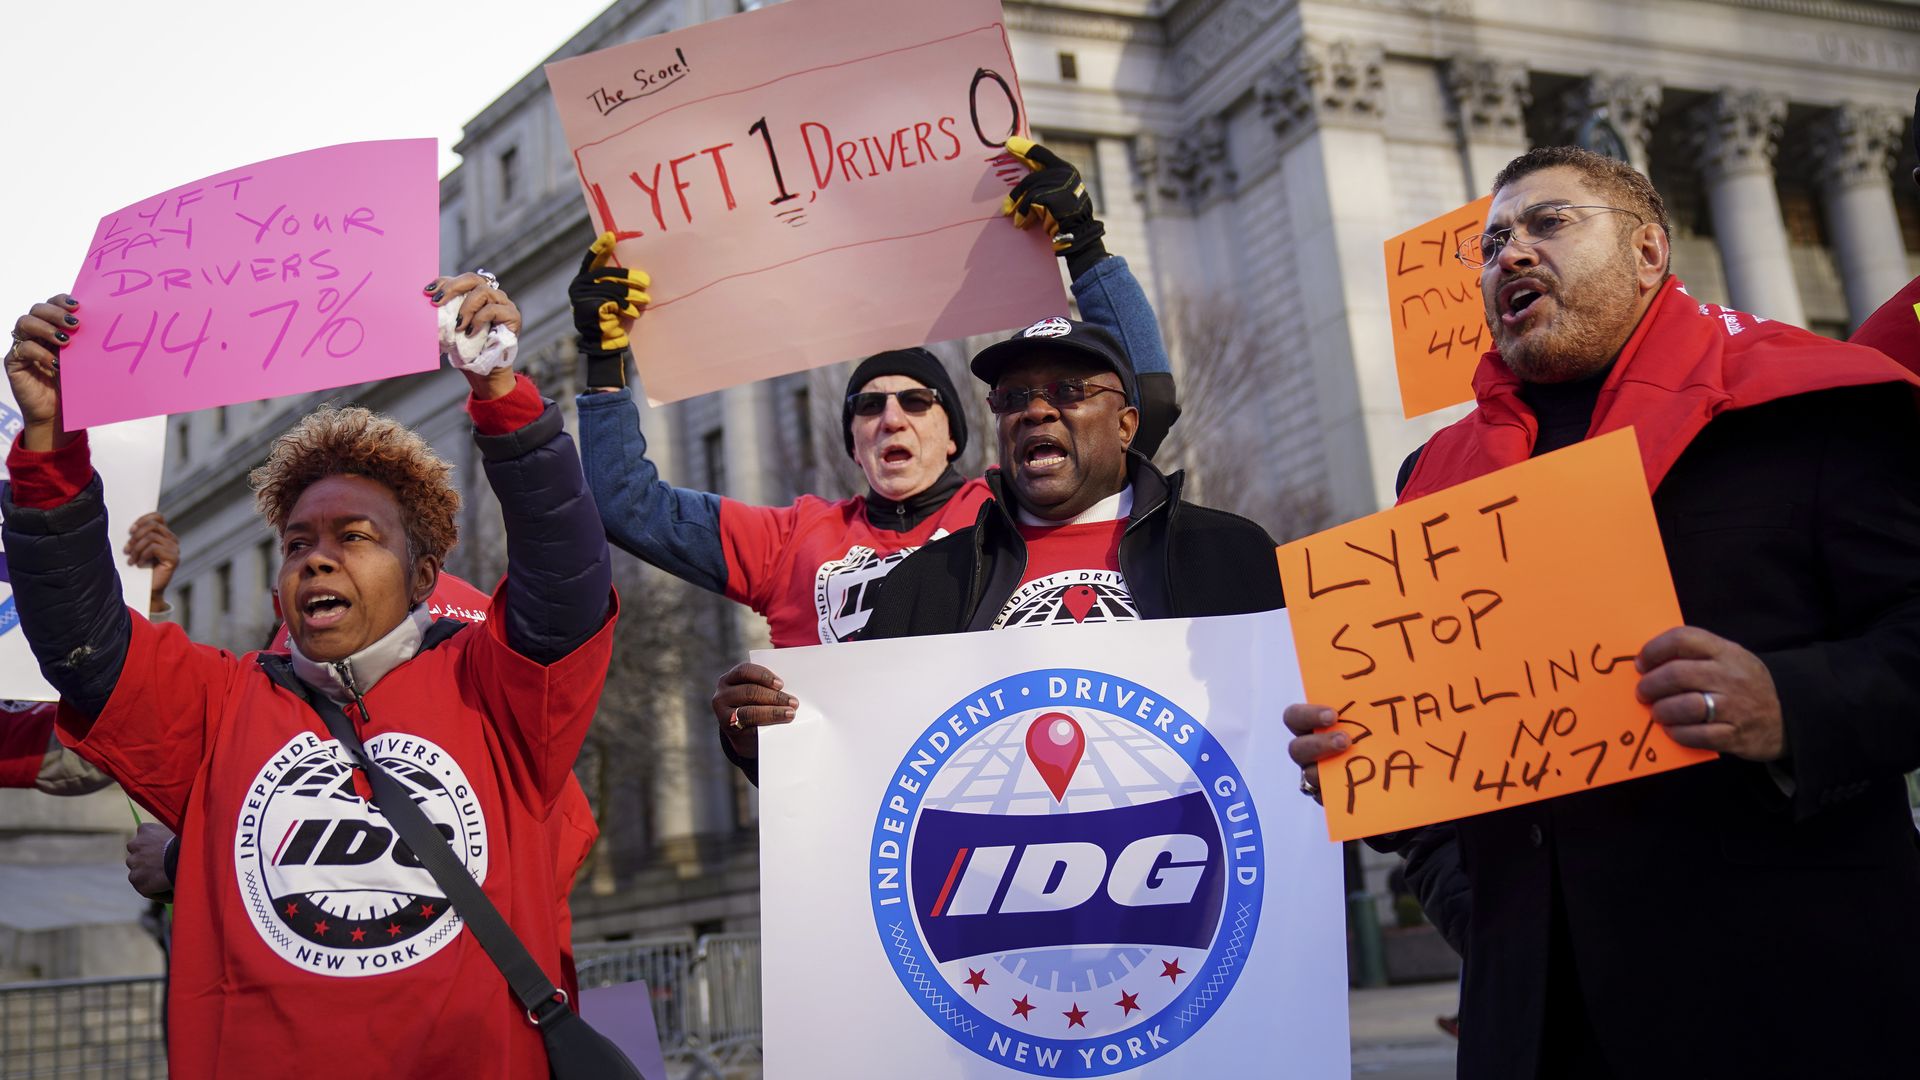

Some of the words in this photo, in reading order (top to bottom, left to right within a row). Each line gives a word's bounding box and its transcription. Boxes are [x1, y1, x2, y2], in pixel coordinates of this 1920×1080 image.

[586, 87, 625, 114] The
[633, 47, 691, 90] Score!
[592, 142, 737, 243] LYFT
[969, 67, 1019, 148] 0
[89, 217, 193, 270] PAY
[104, 175, 254, 241] LYFT
[1397, 219, 1480, 277] LYF
[101, 248, 340, 297] DRIVERS
[101, 271, 373, 379] 44.7%
[1304, 495, 1520, 600] LYFT
[1330, 588, 1504, 681] STOP
[1335, 643, 1640, 746] STALLING
[240, 735, 339, 860] INDEPENDET
[370, 738, 441, 767] RIVERS
[454, 784, 484, 858] GUILD
[877, 688, 1007, 906] INDEPENDENT
[1048, 676, 1196, 746] DRIVERS
[1213, 774, 1258, 886] GUILD
[1344, 730, 1467, 815] PAY
[1510, 706, 1578, 759] NO
[1472, 718, 1658, 802] 44.7%
[945, 832, 1210, 918] IDG
[295, 945, 345, 970] NEW
[357, 943, 421, 970] YORK
[987, 1031, 1062, 1069] NEW
[1078, 1024, 1170, 1070] YORK
